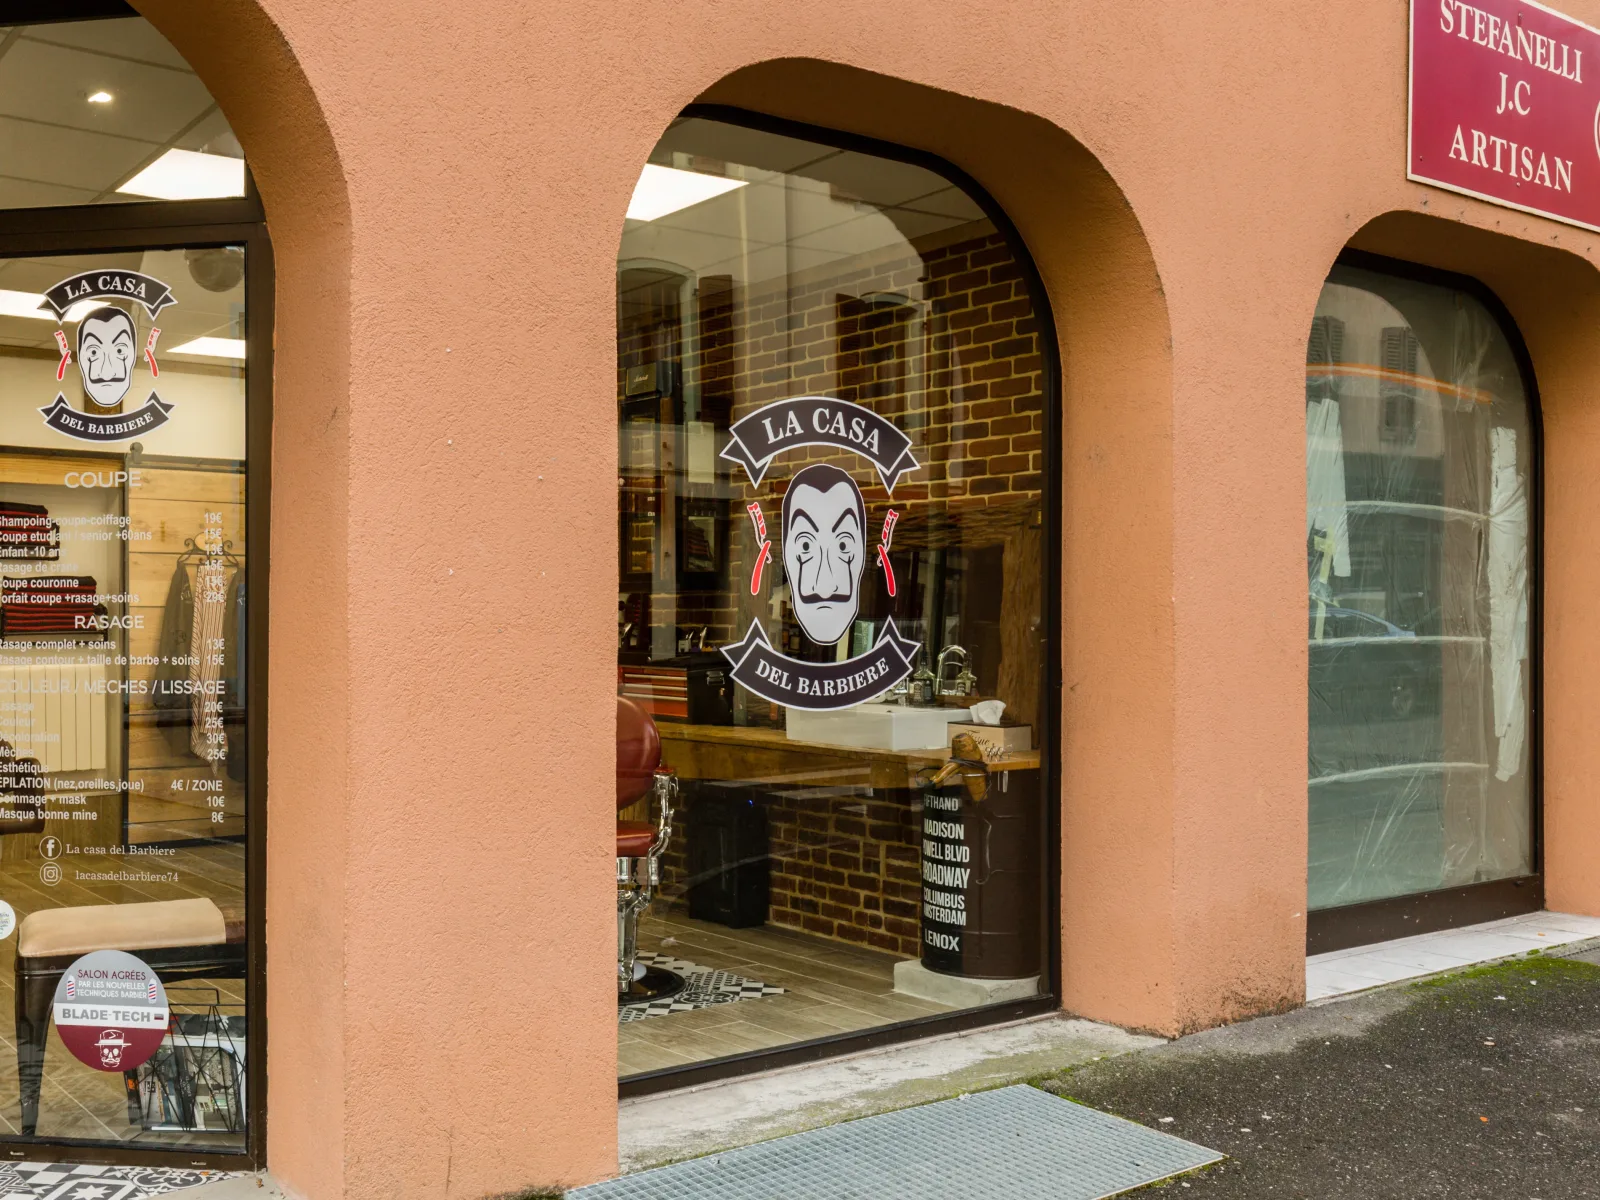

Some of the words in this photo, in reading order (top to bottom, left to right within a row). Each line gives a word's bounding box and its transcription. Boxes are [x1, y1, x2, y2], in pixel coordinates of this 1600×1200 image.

[1440, 0, 1583, 84] STEFANELLI
[1496, 72, 1531, 115] J.C
[1449, 124, 1573, 194] ARTISAN
[64, 280, 92, 300] LA
[98, 276, 146, 298] CASA
[60, 413, 84, 431] DEL
[87, 412, 153, 435] BARBIERE
[761, 410, 804, 445] LA
[812, 407, 880, 455] CASA
[64, 471, 142, 488] COUPE
[0, 514, 132, 529] hampoing-coupe-coiffage
[0, 546, 28, 558] nfant
[30, 546, 46, 558] -10
[48, 548, 67, 557] ans
[35, 561, 48, 573] de
[30, 577, 80, 589] couronne
[0, 591, 29, 604] orfait
[31, 593, 62, 606] coupe
[74, 615, 145, 630] RASAGE
[35, 638, 77, 653] complet
[88, 639, 117, 650] soins
[87, 654, 112, 665] taille
[114, 654, 127, 665] de
[130, 654, 160, 666] barbe
[171, 654, 200, 666] soins
[755, 658, 792, 690] DEL
[796, 657, 889, 697] BARBIERE
[161, 680, 226, 695] LISSAGE
[0, 701, 35, 713] issage
[204, 701, 223, 713] 20€
[205, 717, 224, 729] 25€
[206, 732, 225, 744] 30€
[207, 748, 226, 760] 25€
[171, 779, 183, 791] 4€
[192, 780, 223, 792] ZONE
[59, 794, 87, 805] mask
[206, 795, 225, 807] 10€
[38, 809, 70, 820] bonne
[72, 809, 98, 821] mine
[211, 812, 225, 823] 8€
[66, 844, 80, 854] La
[83, 846, 106, 854] casa
[109, 845, 125, 855] del
[129, 845, 176, 856] Barbiere
[945, 844, 970, 863] BLVD
[75, 870, 179, 882] lacasadelbarbiere74
[925, 928, 960, 952] LENOX
[78, 970, 108, 979] SALON
[112, 970, 146, 981] AGRÉES
[106, 982, 146, 990] NOUVELLES
[77, 989, 119, 998] TECHNIQUES
